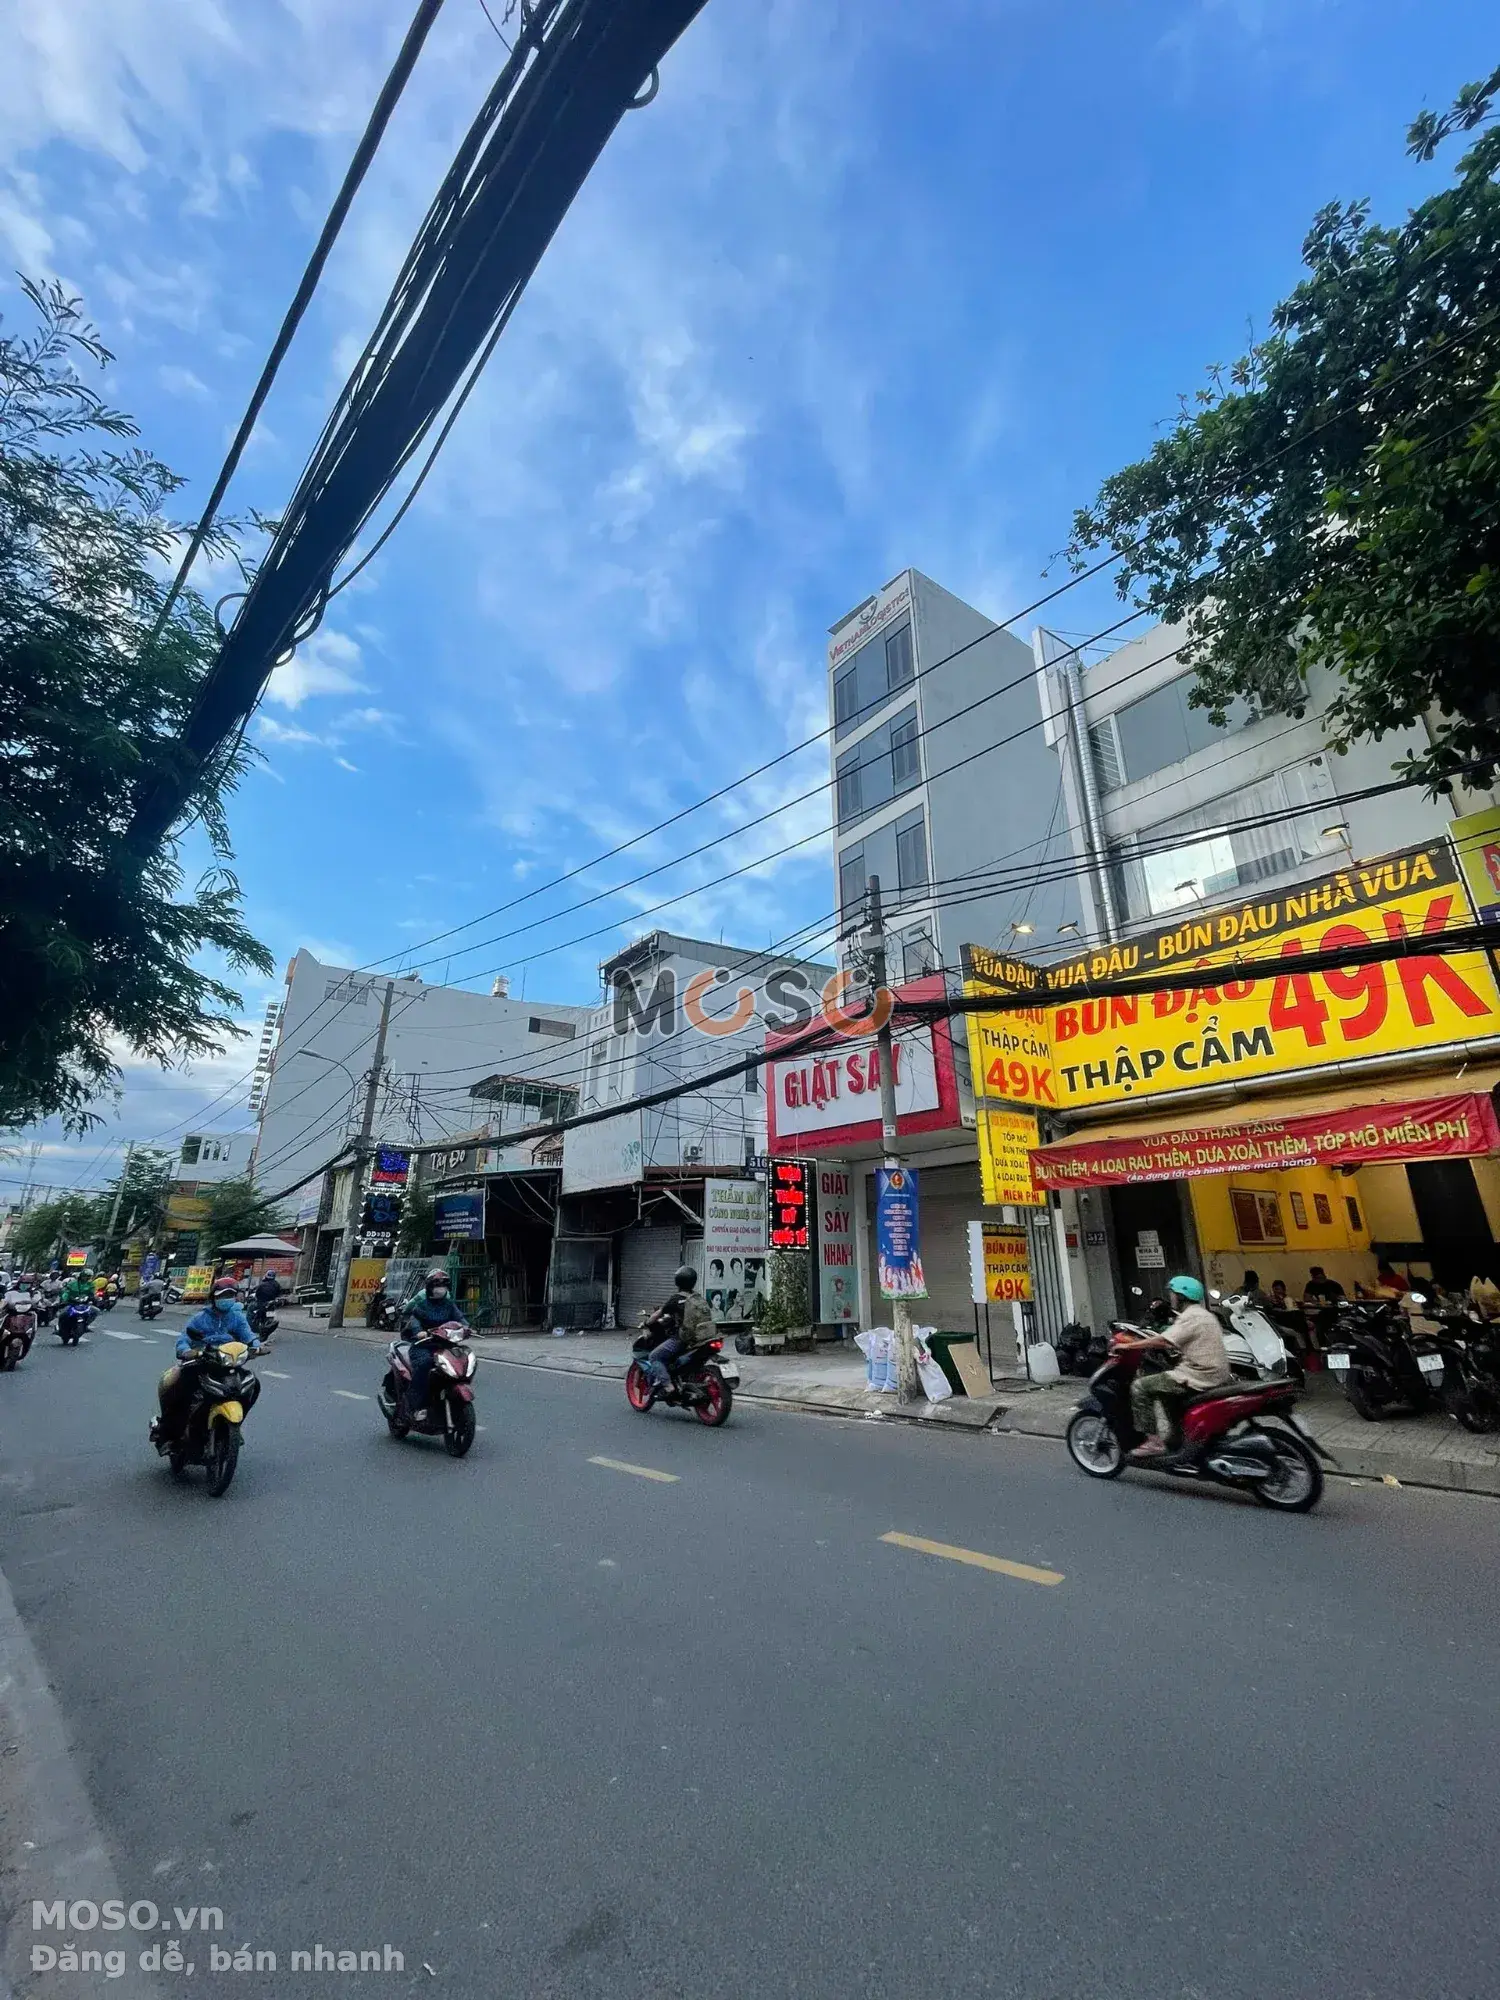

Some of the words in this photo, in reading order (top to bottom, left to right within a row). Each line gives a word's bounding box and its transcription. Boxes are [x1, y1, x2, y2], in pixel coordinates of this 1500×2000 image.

[1046, 962, 1087, 988] VUA
[1091, 946, 1139, 979] ĐẬU
[1158, 921, 1212, 960] BÚN
[1217, 903, 1278, 942] ĐẬU
[1286, 873, 1357, 921] NHÀ
[1360, 853, 1437, 897] VUA
[975, 952, 1004, 979] VUA
[1006, 963, 1035, 989] ĐẬU
[1269, 895, 1493, 1047] 49K
[982, 1027, 1019, 1056] THẬP
[1022, 1029, 1050, 1059] CẨM
[1060, 1045, 1165, 1093] THẬP
[1173, 1015, 1275, 1071] CẨM
[986, 1057, 1056, 1103] 49K
[1092, 1161, 1099, 1174] 4
[1101, 1157, 1127, 1175] LOẠI
[1129, 1154, 1153, 1171] RAU
[1154, 1146, 1195, 1168] THÊM,
[1196, 1145, 1226, 1165] DƯA
[1226, 1138, 1262, 1161] XOÀI
[1264, 1134, 1312, 1158] THÊM,
[1313, 1129, 1346, 1151] TÓP
[1382, 1115, 1431, 1145] MIỄN
[1434, 1112, 1470, 1140] PHÍ
[1142, 1135, 1169, 1148] VUA
[1170, 1131, 1199, 1146] ĐẬU
[1253, 1162, 1279, 1170] mua
[1281, 1156, 1317, 1169] hàng)
[822, 1169, 849, 1199] GIẶT
[824, 1203, 849, 1233] SẤY
[986, 1240, 1005, 1255] BÚN
[1007, 1240, 1026, 1258] ĐẬU
[994, 1278, 1026, 1301] 49K
